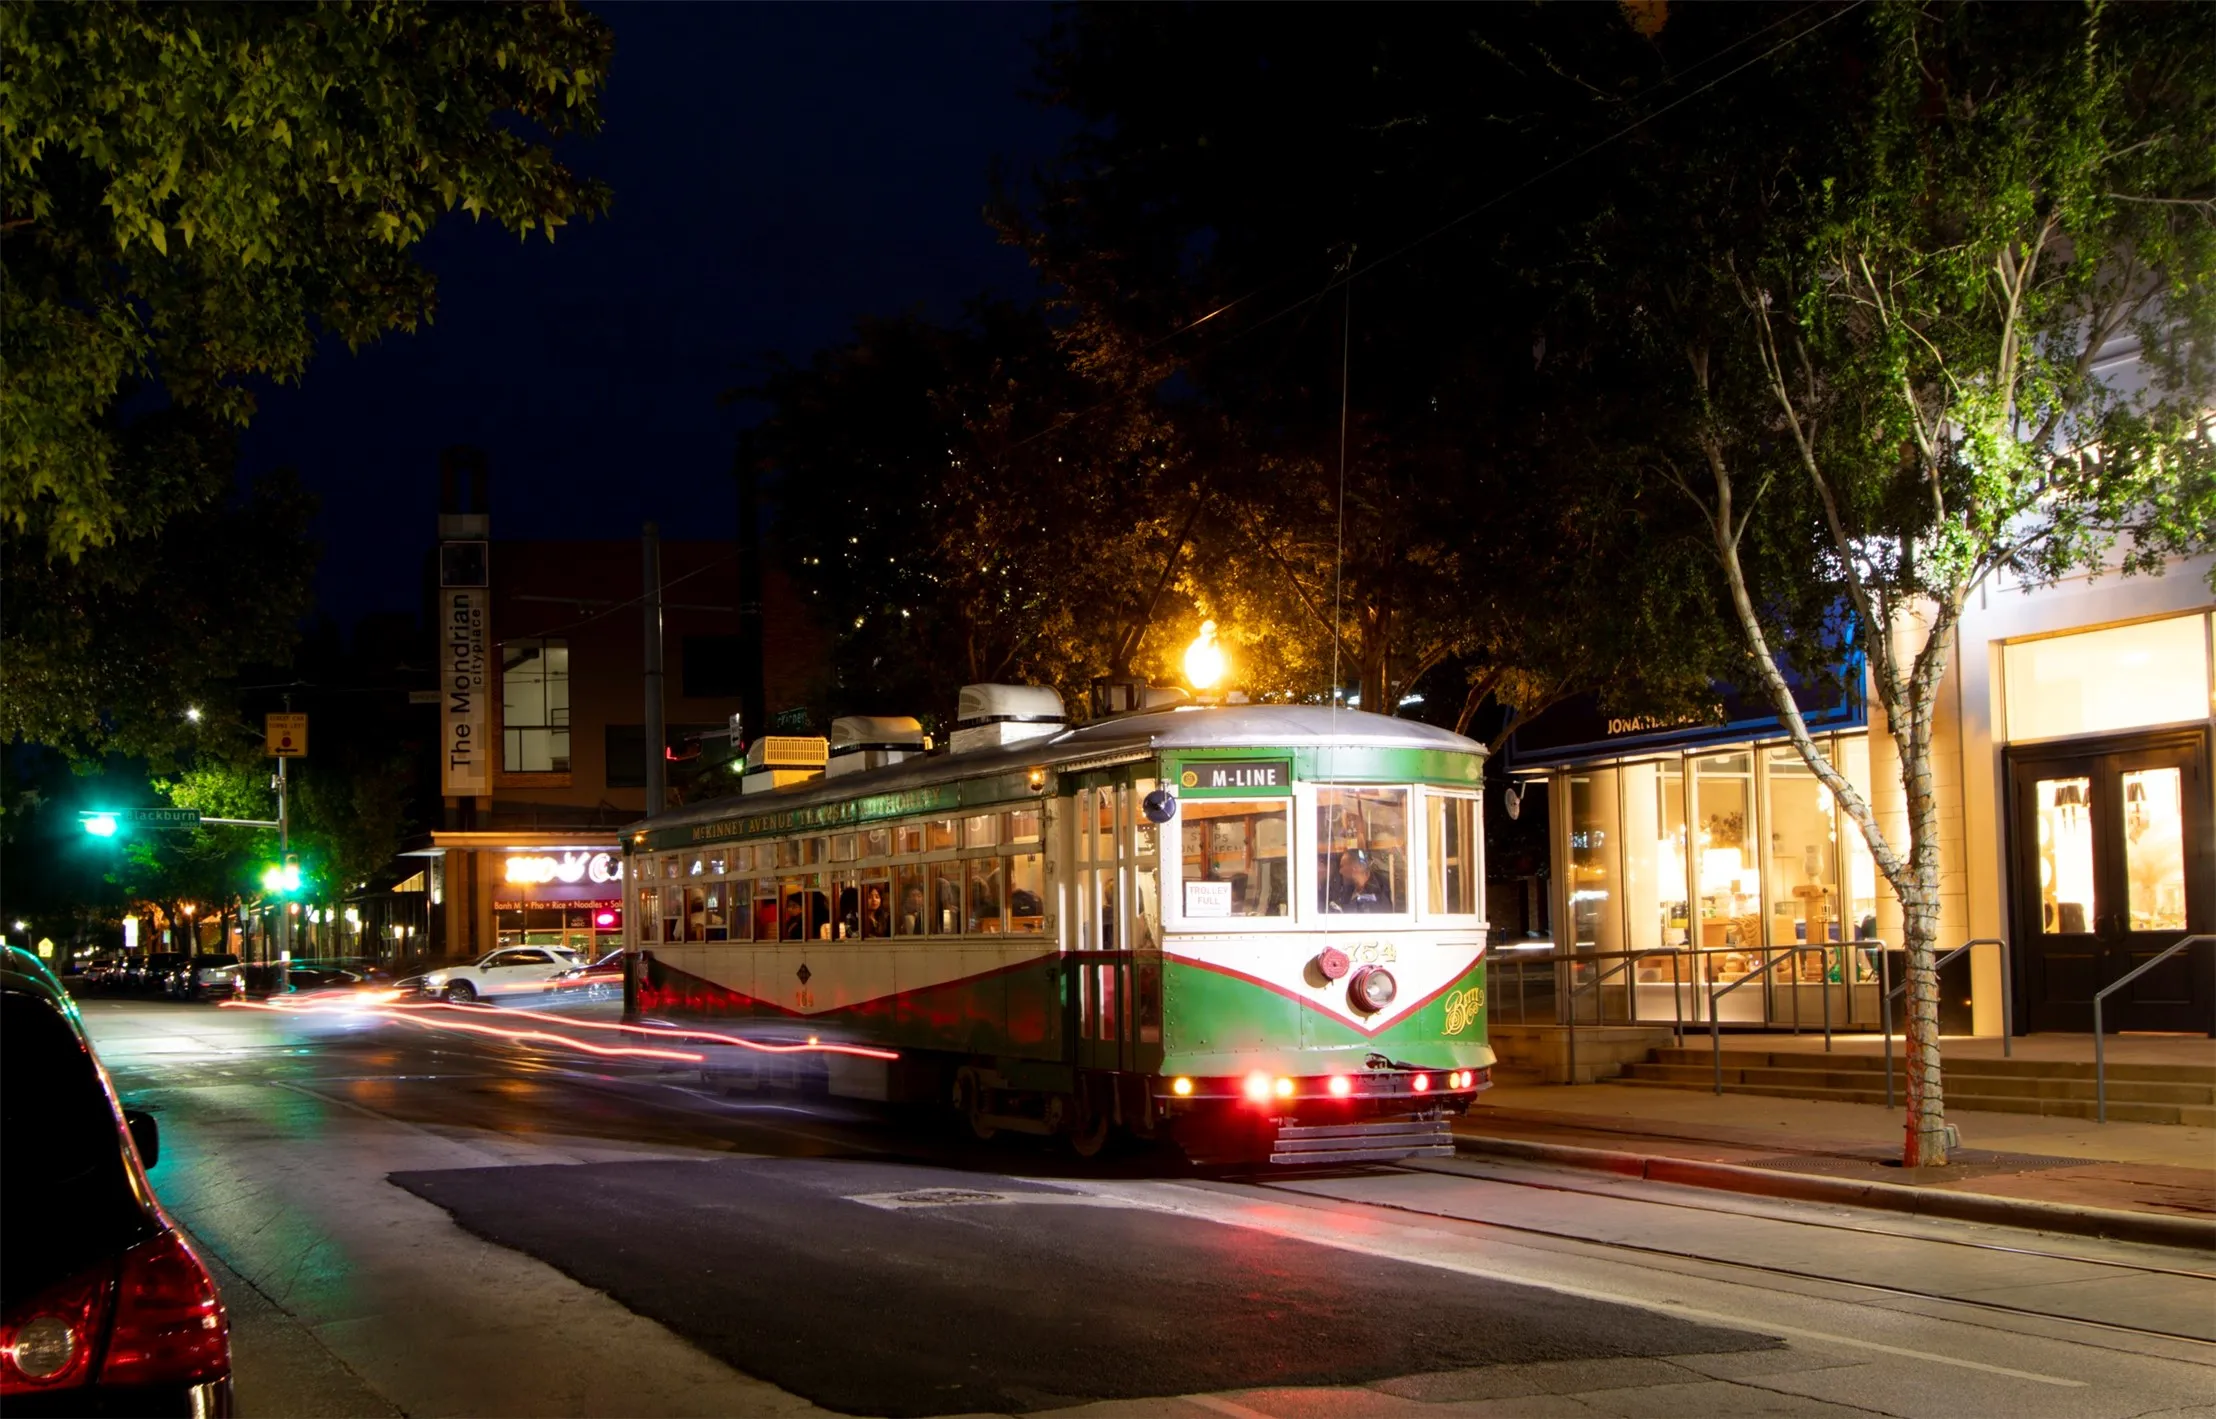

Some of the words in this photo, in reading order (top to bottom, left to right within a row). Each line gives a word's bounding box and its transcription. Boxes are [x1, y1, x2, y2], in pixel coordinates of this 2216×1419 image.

[449, 594, 471, 713] Mondrian
[471, 608, 485, 685] cityplace
[451, 724, 471, 771] The
[1212, 768, 1276, 787] M-LINE
[126, 810, 196, 821] Blackburn
[748, 811, 793, 833] AVENUE
[1189, 886, 1228, 895] TROLLEY
[1197, 896, 1220, 905] FULL
[494, 901, 513, 910] Banh
[530, 901, 544, 909] Pho
[552, 901, 566, 909] Rice
[574, 900, 602, 909] Noodles
[1343, 941, 1397, 963] 754
